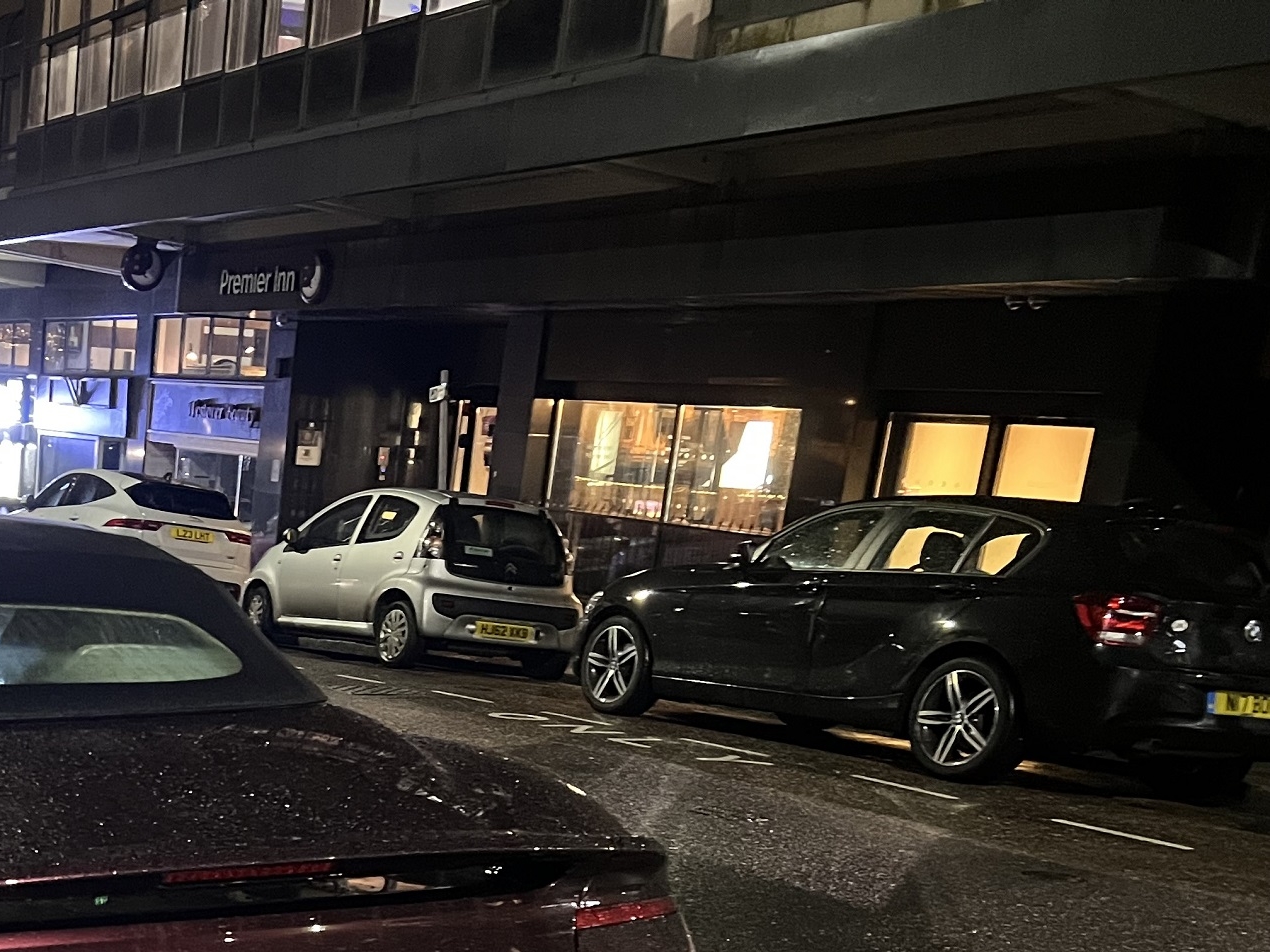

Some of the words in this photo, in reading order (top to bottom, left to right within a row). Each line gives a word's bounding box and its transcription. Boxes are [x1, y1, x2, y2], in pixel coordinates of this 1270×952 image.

[219, 267, 272, 295] Premier
[273, 265, 295, 293] Inn
[176, 529, 193, 539] L23
